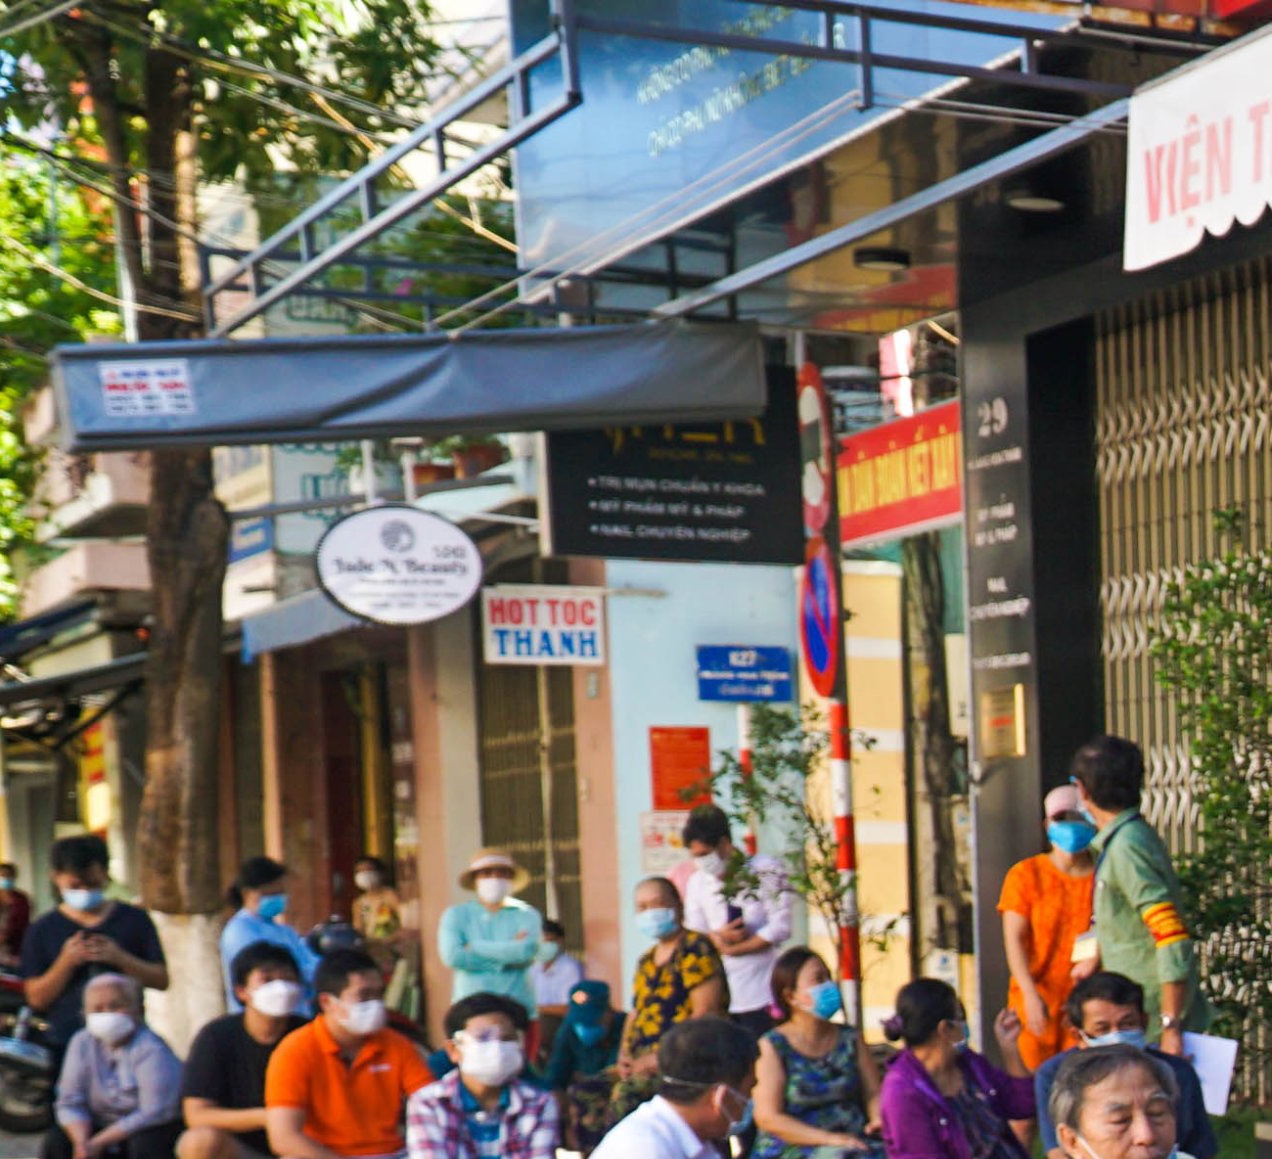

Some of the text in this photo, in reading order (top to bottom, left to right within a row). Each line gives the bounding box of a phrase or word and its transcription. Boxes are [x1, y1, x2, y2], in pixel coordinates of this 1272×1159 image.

[1144, 114, 1233, 228] VIỆN
[978, 397, 1007, 437] 29
[492, 629, 600, 658] THANH
